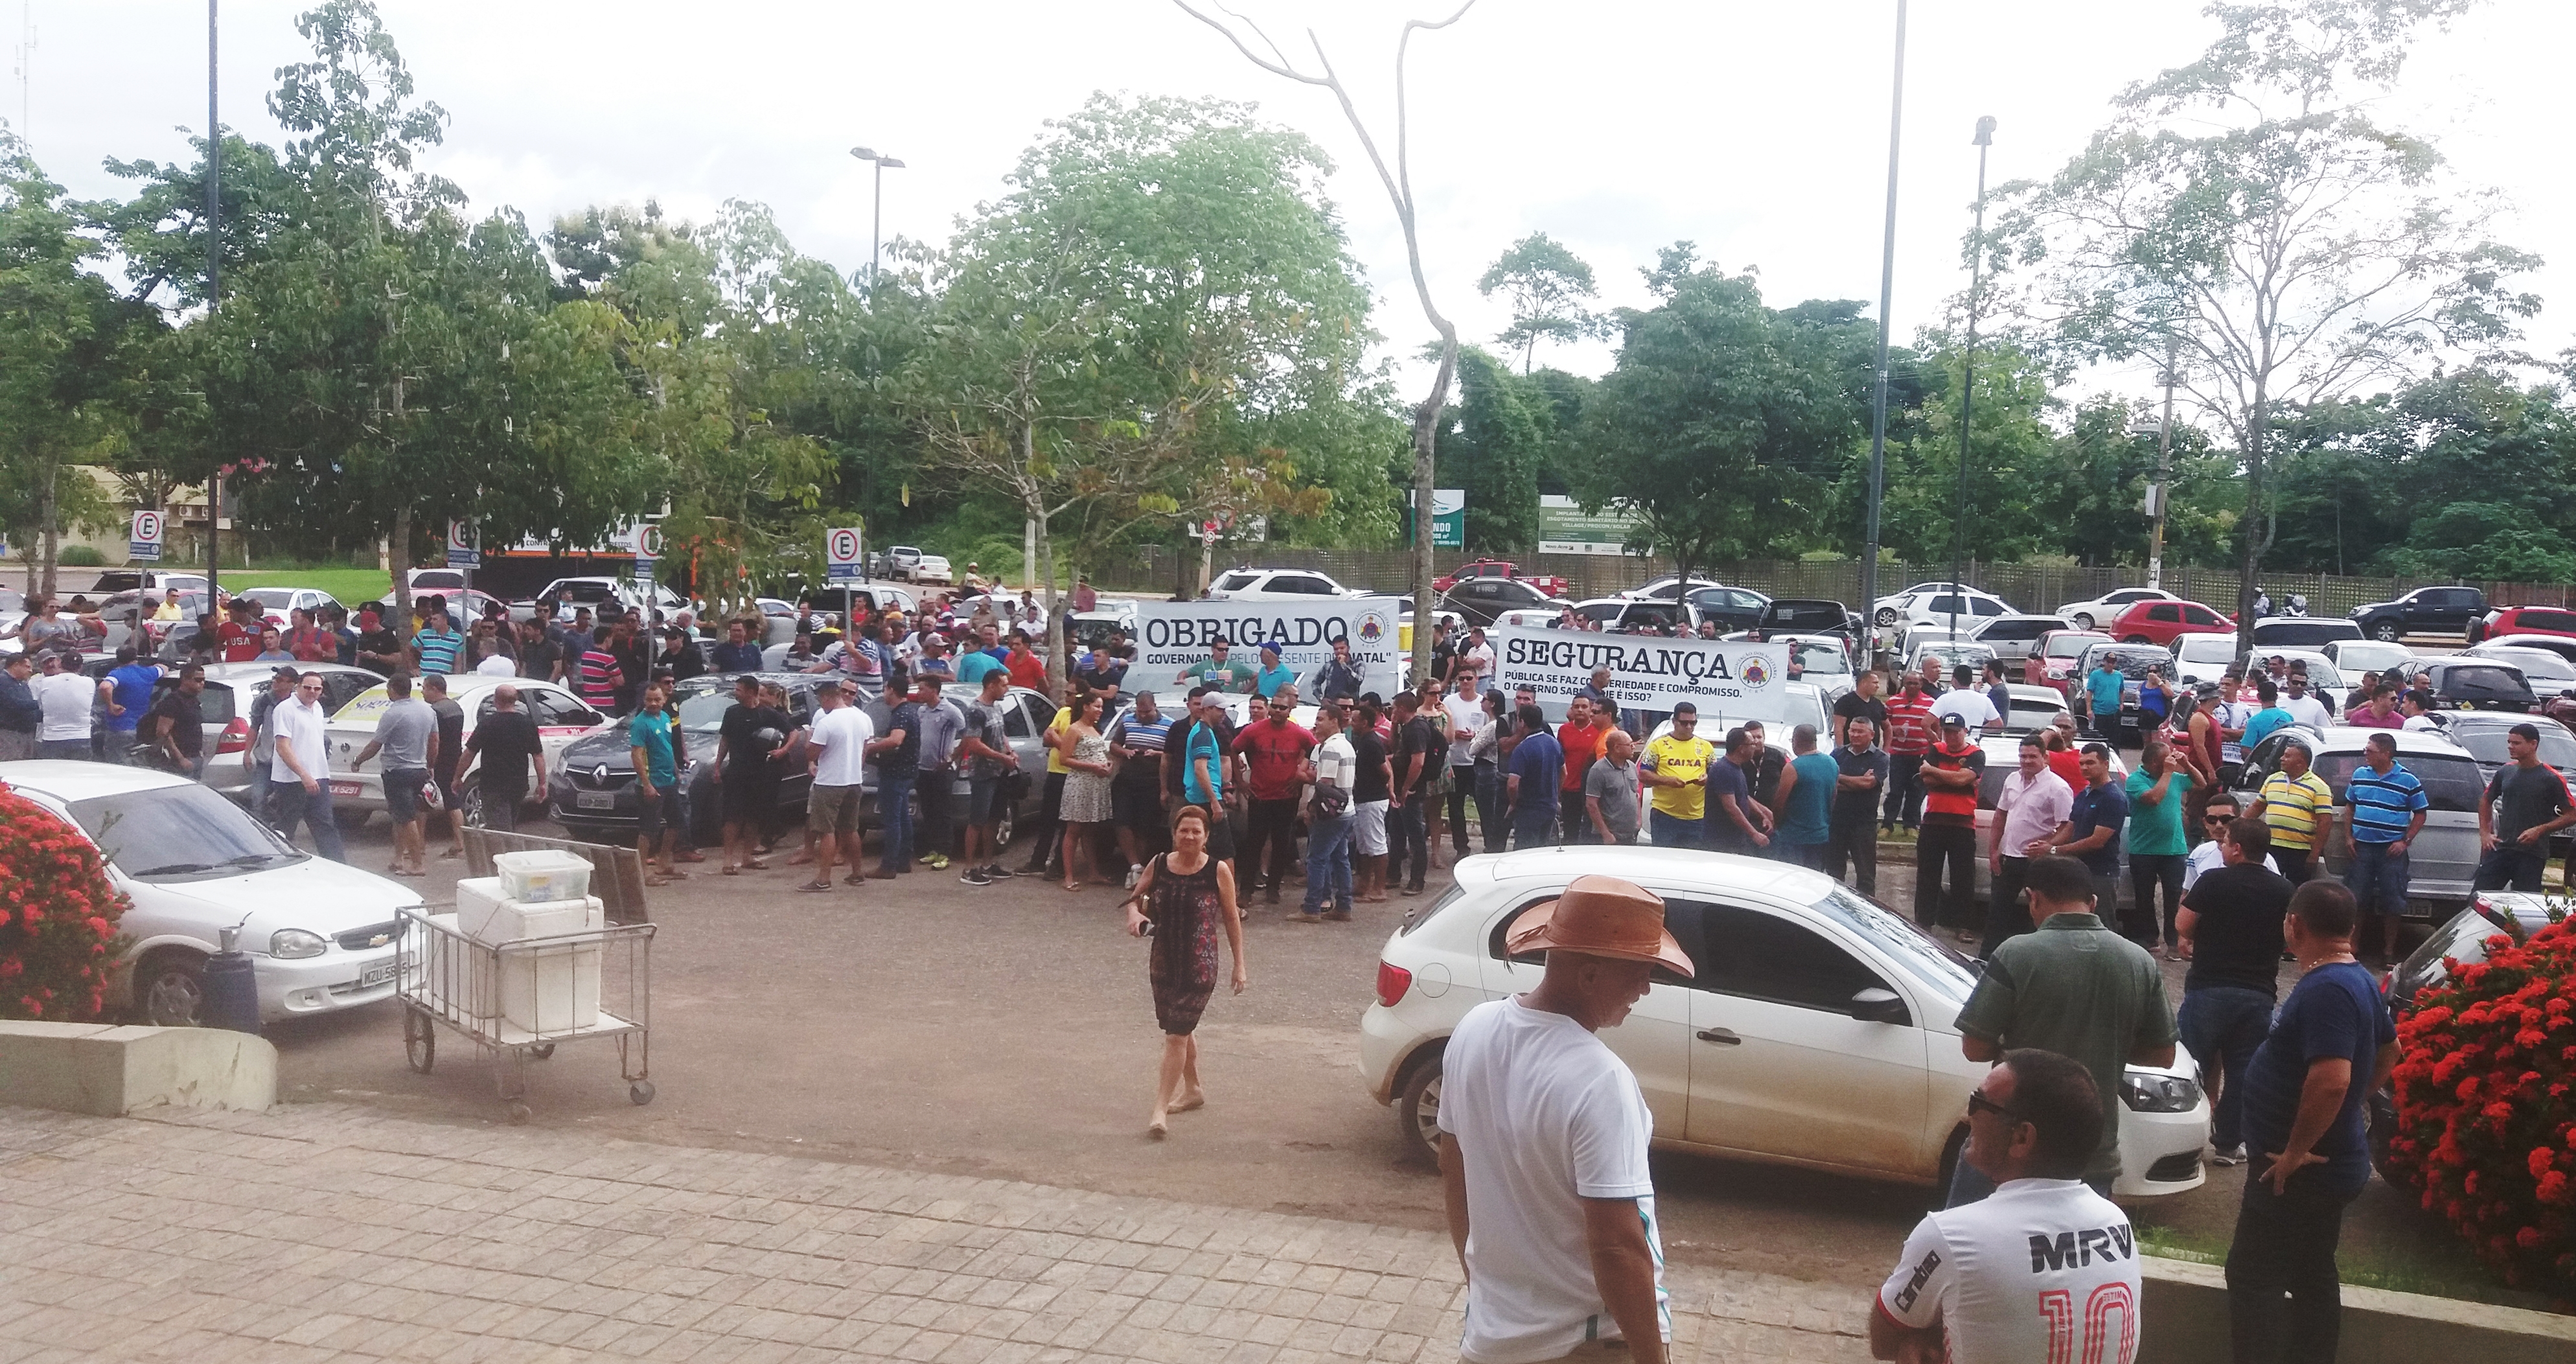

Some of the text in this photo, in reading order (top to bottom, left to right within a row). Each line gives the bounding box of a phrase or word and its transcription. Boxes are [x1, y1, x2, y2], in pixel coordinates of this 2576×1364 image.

[143, 518, 154, 535] E
[840, 537, 850, 554] E
[231, 637, 251, 646] USA
[1147, 617, 1348, 648] OBRIGADO
[1506, 638, 1733, 686] SEGURANÇA
[1504, 682, 1511, 690] O
[1616, 689, 1622, 699] É
[1625, 692, 1651, 702] ISSO?
[1505, 669, 1543, 681] PÚBLICA
[1546, 675, 1558, 683] SE
[1559, 676, 1578, 685] FAZ
[1606, 679, 1657, 691] ERIEDADE
[1666, 684, 1743, 699] COMPROMISSO.
[1668, 759, 1701, 767] CAIXA
[364, 962, 408, 985] MZU-585
[2029, 1223, 2132, 1274] MRV
[1894, 1249, 1942, 1314] Carabao
[2039, 1282, 2135, 1364] 10
